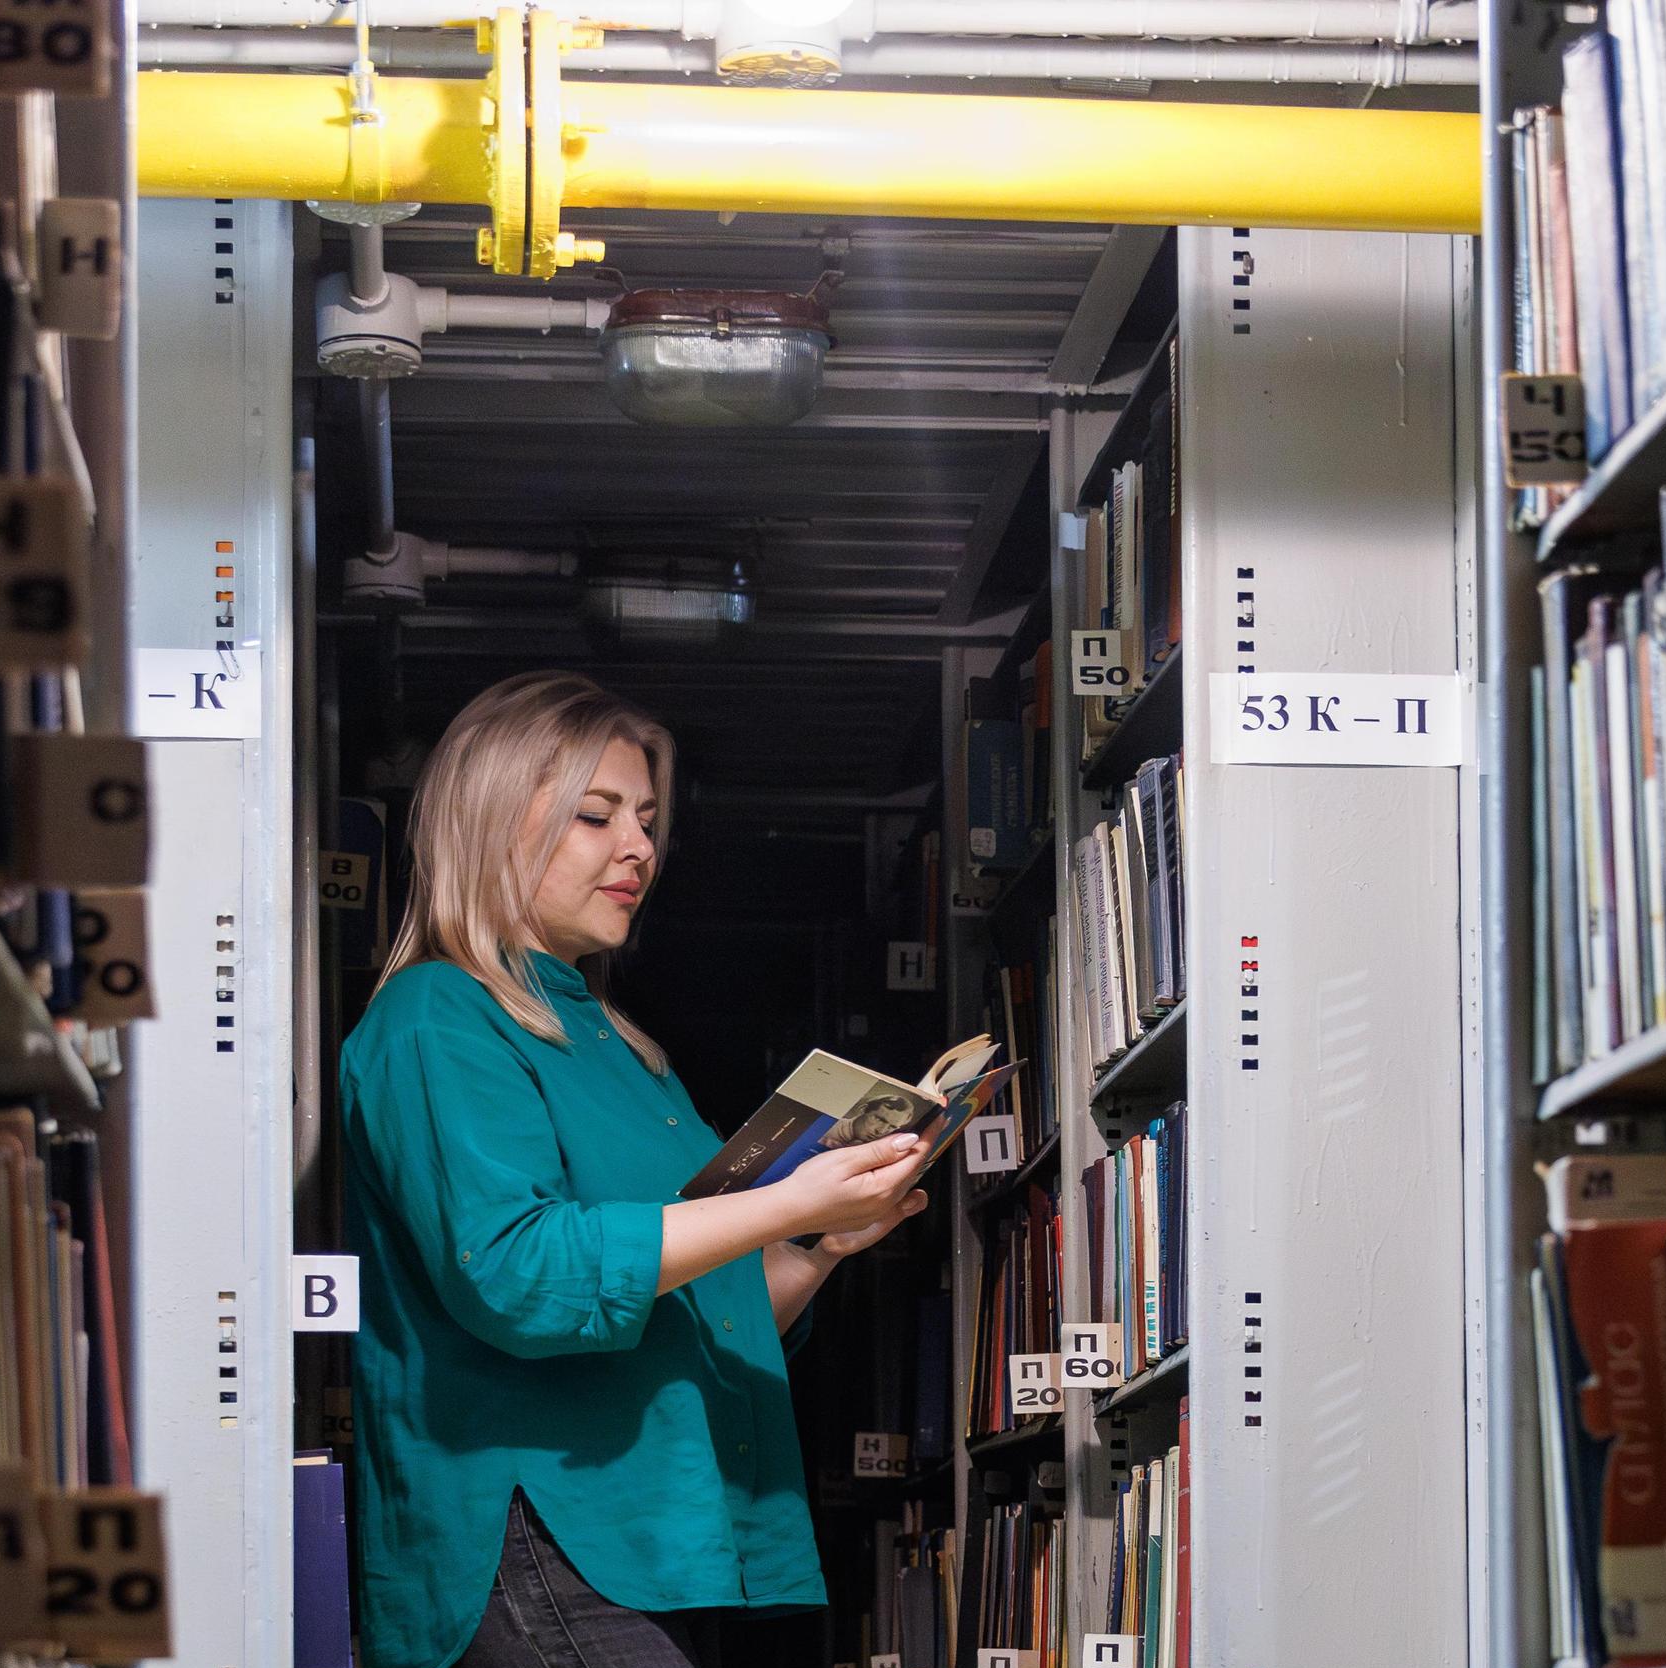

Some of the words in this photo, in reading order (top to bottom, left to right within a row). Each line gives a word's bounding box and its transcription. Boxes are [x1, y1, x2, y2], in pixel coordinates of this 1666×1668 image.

[61, 237, 107, 275] Н
[1083, 637, 1107, 657] П
[1080, 666, 1130, 686] 50
[190, 672, 227, 709] К
[1242, 694, 1290, 731] 53
[1306, 695, 1341, 732] К
[1394, 697, 1429, 734] П
[899, 951, 923, 978] Н
[979, 1128, 1008, 1162] П
[304, 1274, 338, 1318] В
[1074, 1334, 1097, 1352] П
[1021, 1362, 1043, 1379] П
[1065, 1358, 1121, 1378] 60
[1017, 1388, 1061, 1406] 20
[863, 1438, 879, 1452] Н
[77, 1507, 137, 1553] П
[46, 1566, 162, 1617] 20
[1095, 1643, 1119, 1662] П
